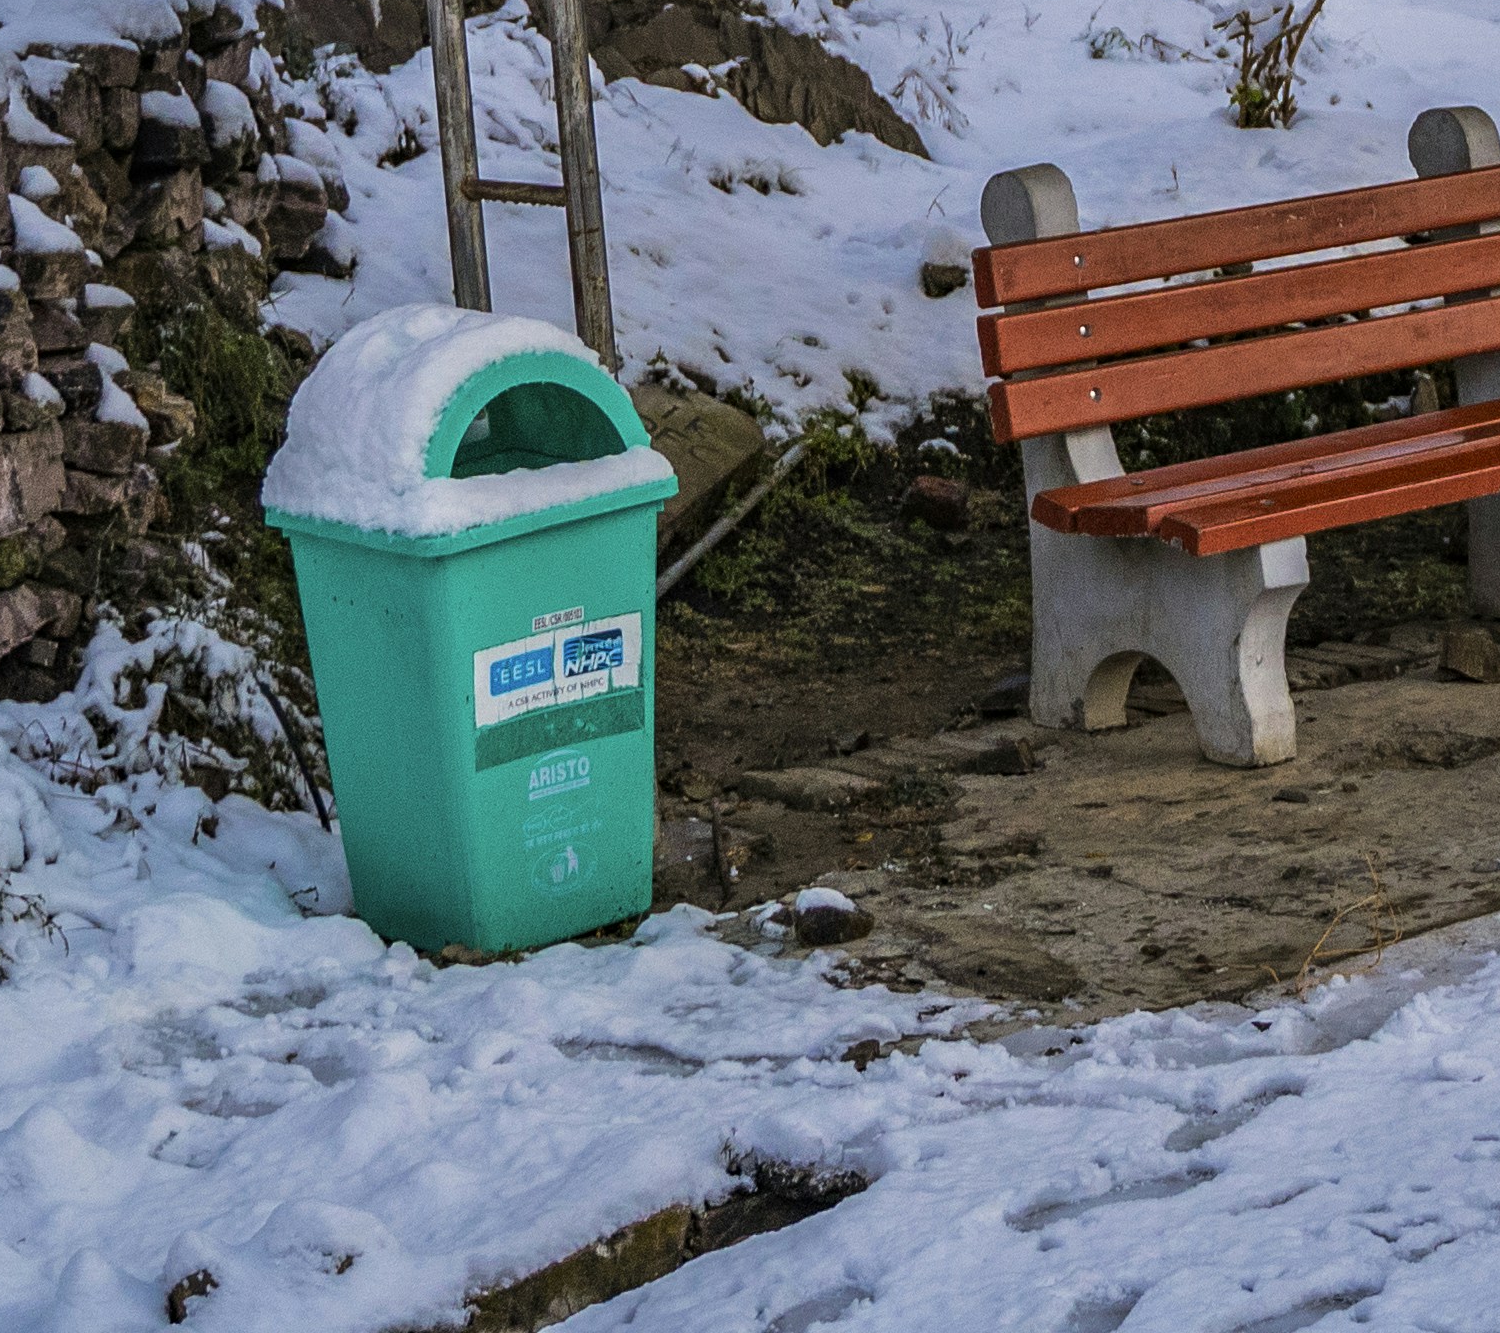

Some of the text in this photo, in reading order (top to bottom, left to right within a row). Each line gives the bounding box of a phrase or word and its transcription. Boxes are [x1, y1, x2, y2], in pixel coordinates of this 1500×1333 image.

[500, 658, 546, 684] EESL
[565, 648, 621, 677] NHPC
[529, 756, 591, 791] ARISTO
